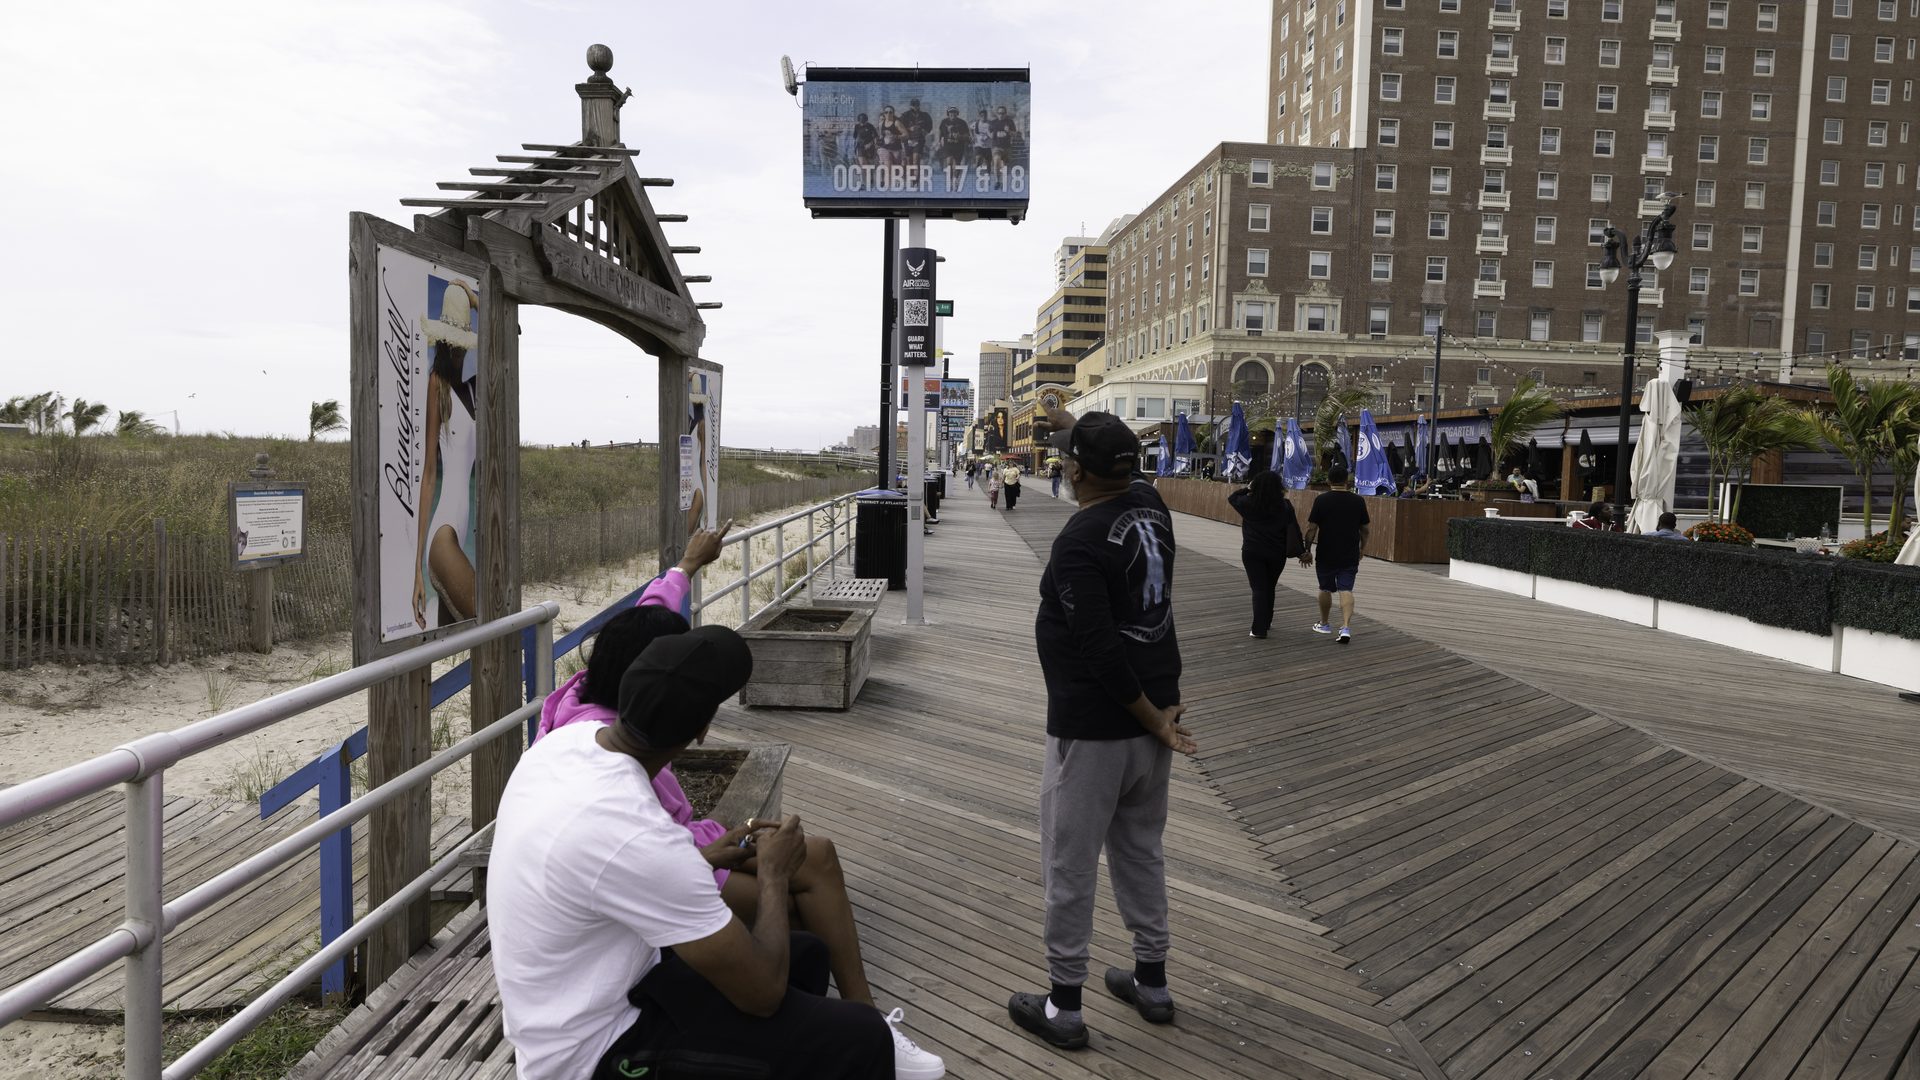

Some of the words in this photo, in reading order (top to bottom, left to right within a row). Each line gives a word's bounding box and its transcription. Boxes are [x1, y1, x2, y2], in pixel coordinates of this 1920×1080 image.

[833, 164, 933, 193] OCTOBER
[943, 164, 968, 193] 17
[975, 165, 990, 193] &
[999, 165, 1025, 193] 18
[581, 255, 648, 312] CALIFORNIA
[655, 293, 672, 318] AVE
[902, 279, 915, 288] AIR
[907, 335, 925, 343] GUARD
[908, 343, 924, 351] WHAT
[1436, 425, 1475, 439] BIERGARTEN
[1112, 511, 1135, 540] NEVER
